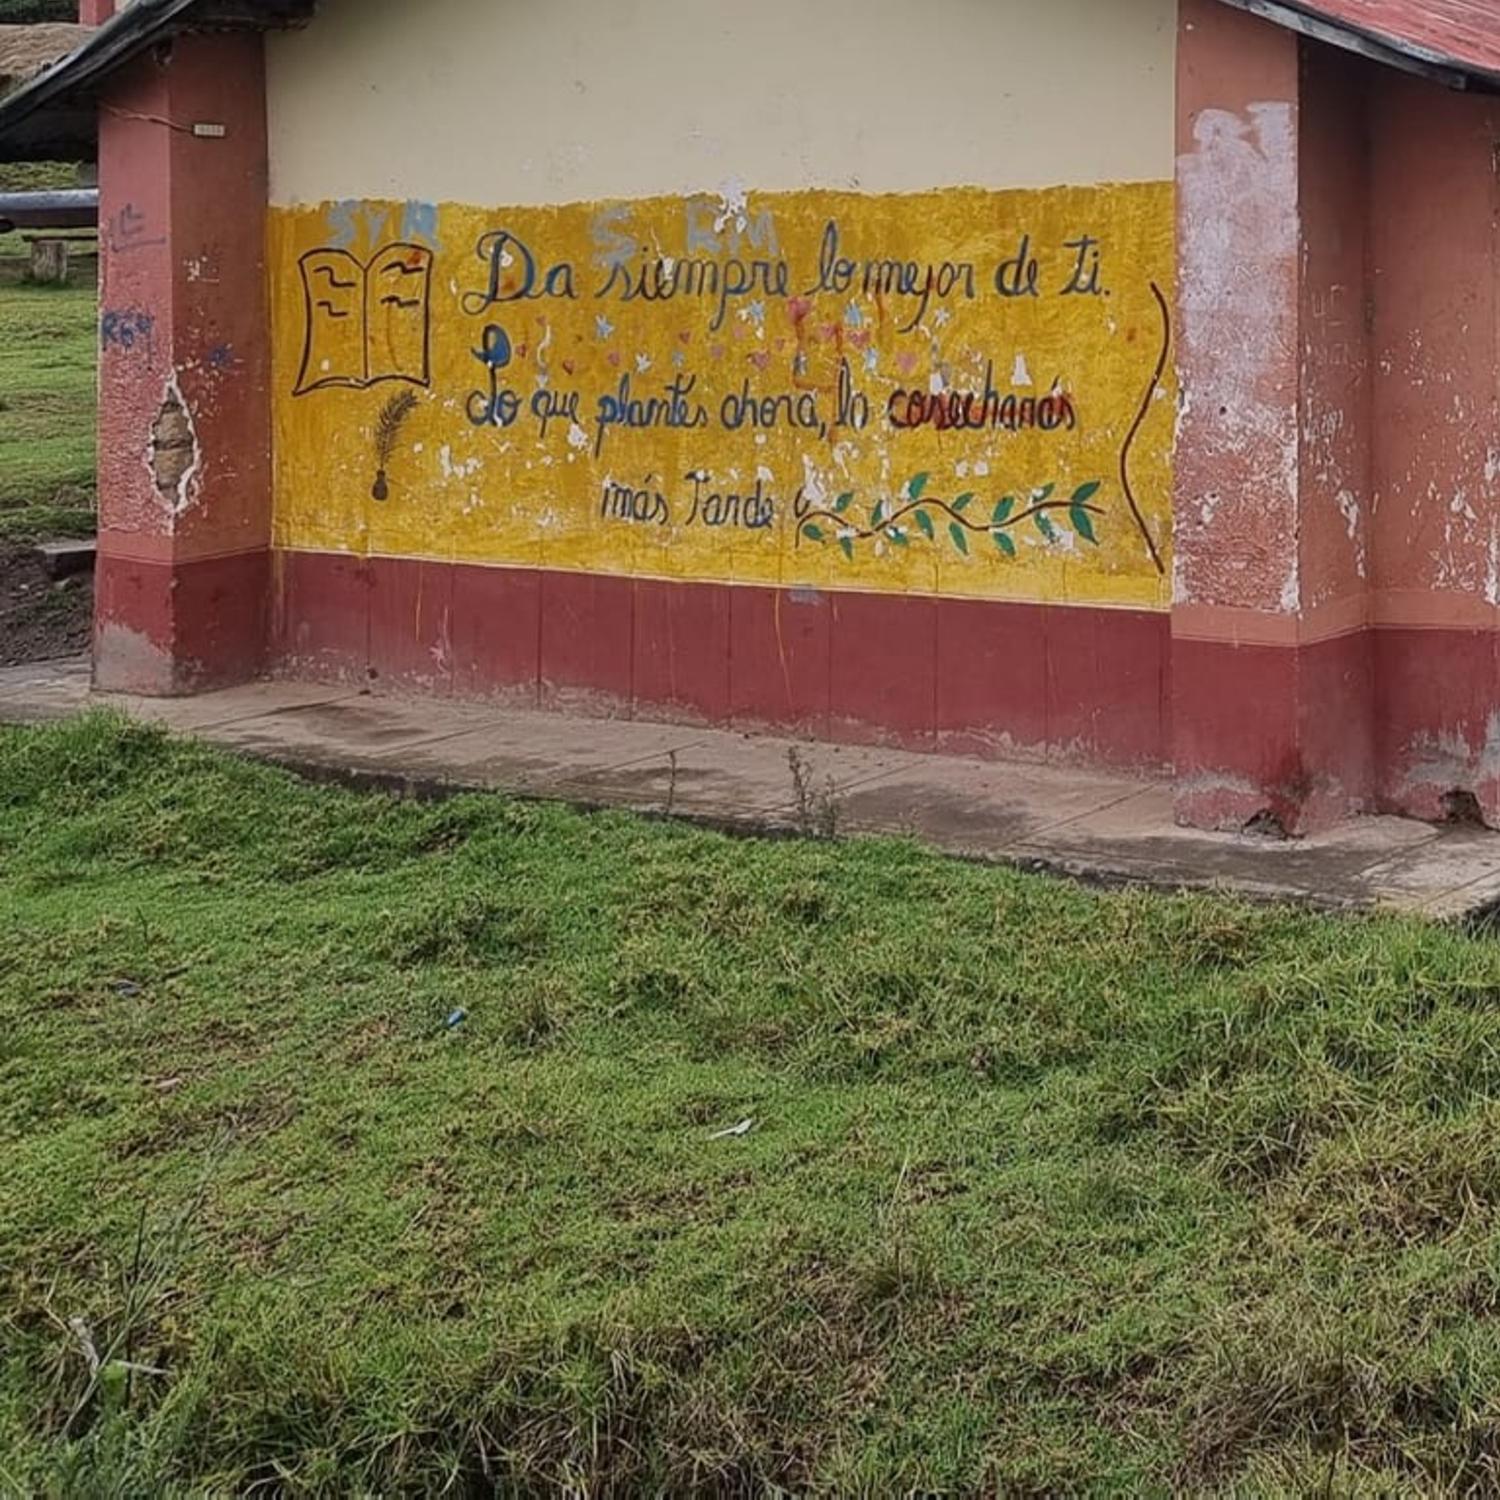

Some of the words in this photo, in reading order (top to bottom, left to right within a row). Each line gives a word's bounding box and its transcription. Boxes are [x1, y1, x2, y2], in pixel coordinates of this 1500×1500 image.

[462, 231, 578, 315] Da
[594, 255, 787, 331] siempre
[804, 220, 855, 296] lo
[863, 263, 974, 334] mejor
[996, 235, 1038, 297] de
[531, 390, 579, 438] que
[595, 373, 708, 458] plantes
[836, 357, 869, 429] lo
